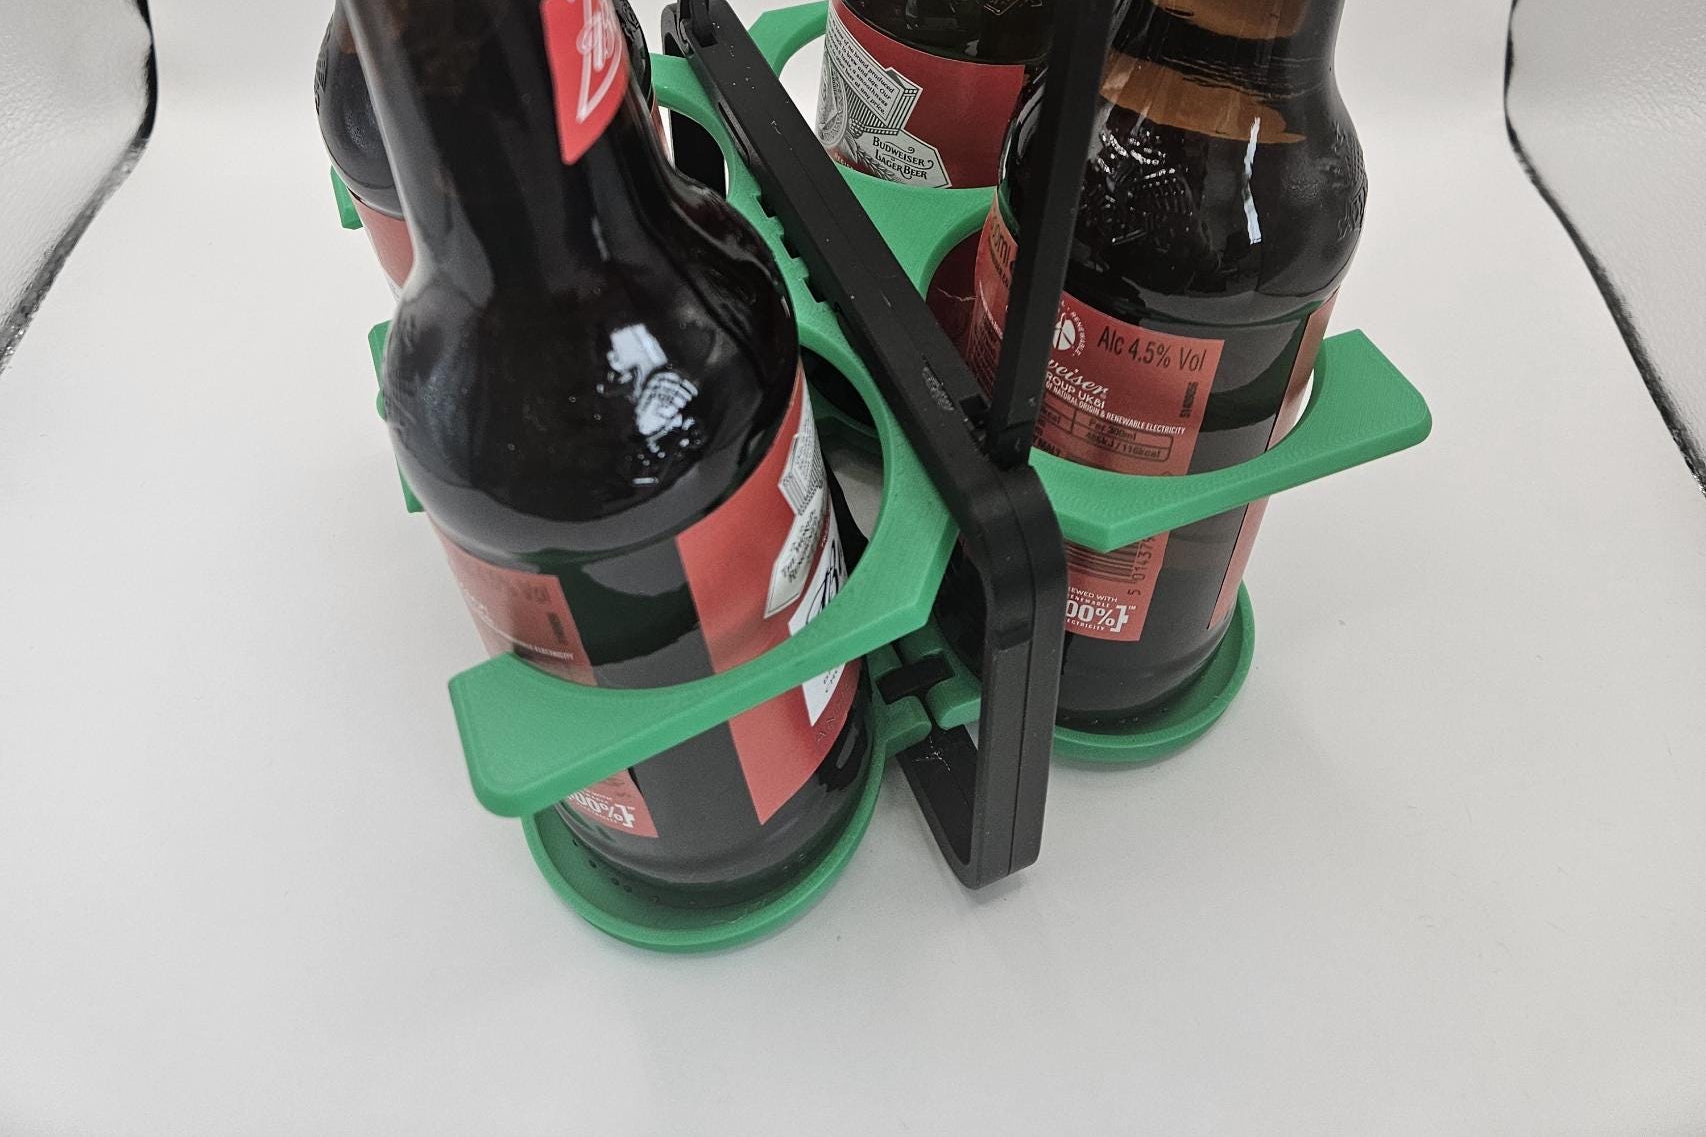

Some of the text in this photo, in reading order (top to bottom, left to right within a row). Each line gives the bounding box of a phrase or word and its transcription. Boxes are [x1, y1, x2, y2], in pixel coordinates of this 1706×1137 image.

[856, 74, 888, 107] smoothness
[857, 66, 868, 78] and
[879, 87, 892, 100] Our
[868, 67, 894, 93] produced
[872, 136, 926, 167] BUDWEISER
[875, 149, 903, 172] LAGER
[903, 165, 928, 180] BEER
[1097, 325, 1207, 372] Alc 4.5% Vol
[1045, 371, 1106, 410] ROUP UK&I
[1048, 358, 1109, 396] weiser
[1052, 385, 1079, 408] NATURAL
[1079, 400, 1101, 417] ORIGIN
[1105, 412, 1146, 431] RENEWABLE
[1145, 421, 1187, 436] ELECTRICITY
[1068, 586, 1118, 603] EWED WITH
[1069, 594, 1110, 609] ENEWABLE
[1066, 599, 1116, 627] 00%
[1066, 617, 1106, 632] ECTRICITY
